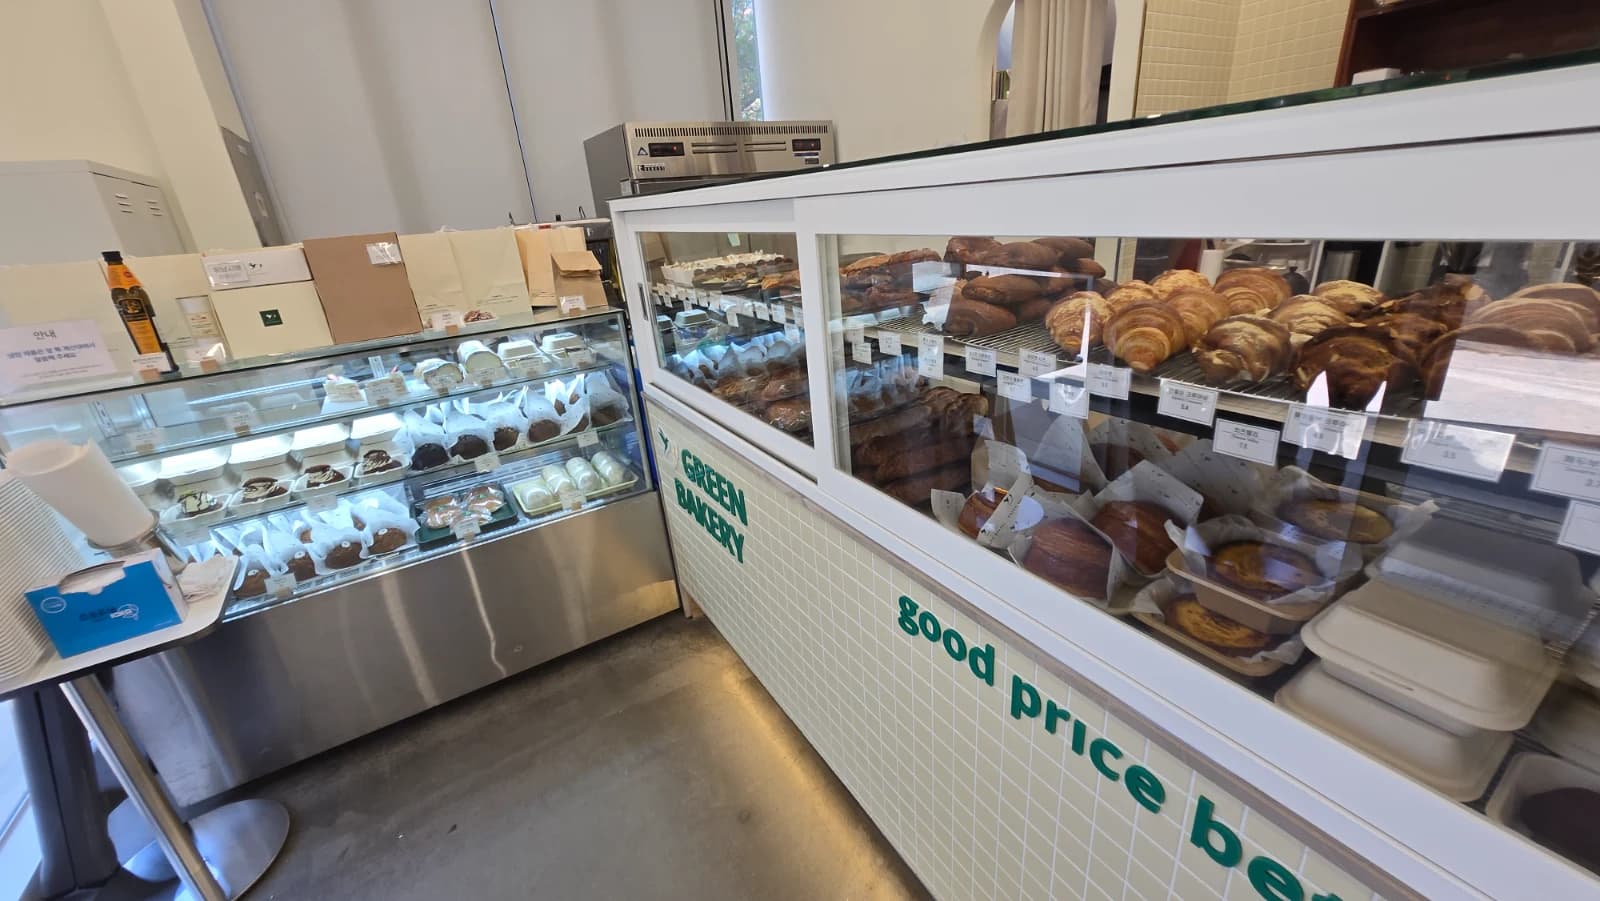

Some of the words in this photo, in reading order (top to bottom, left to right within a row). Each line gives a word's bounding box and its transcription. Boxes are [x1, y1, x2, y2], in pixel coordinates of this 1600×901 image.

[33, 328, 57, 340] 안내
[674, 478, 745, 563] BAKERY
[681, 449, 748, 526] GREEN
[898, 595, 995, 687] good
[1010, 674, 1166, 814] price
[1190, 795, 1342, 901] be
